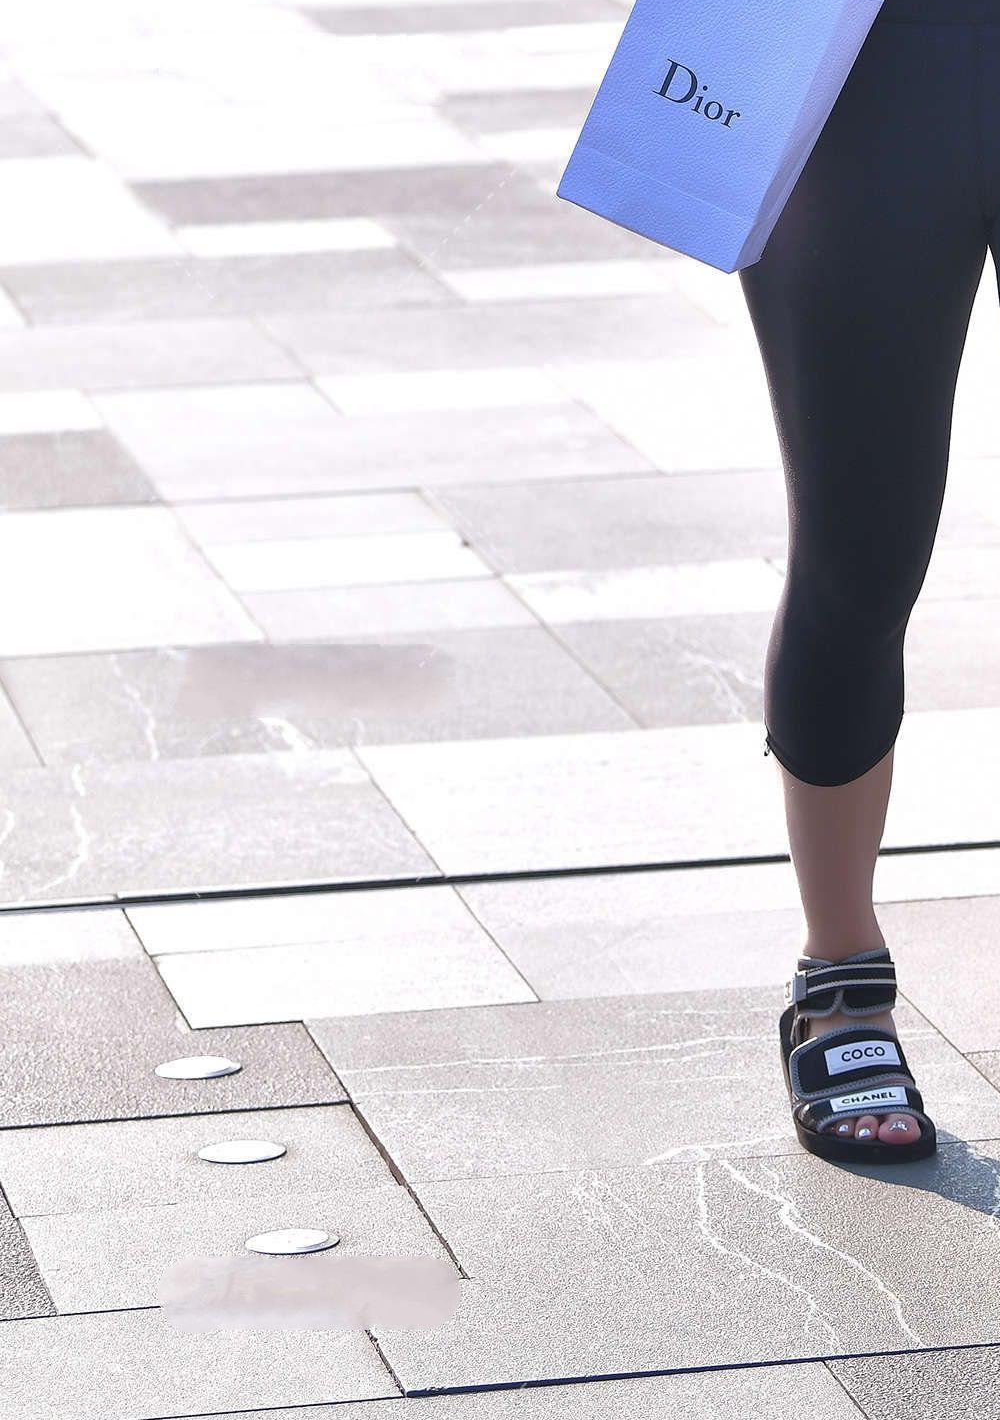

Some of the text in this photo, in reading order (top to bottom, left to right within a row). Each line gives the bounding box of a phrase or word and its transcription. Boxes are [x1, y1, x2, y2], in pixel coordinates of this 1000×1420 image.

[652, 58, 741, 129] Dior
[841, 1046, 886, 1062] COCO
[841, 1091, 897, 1105] CHANEL
